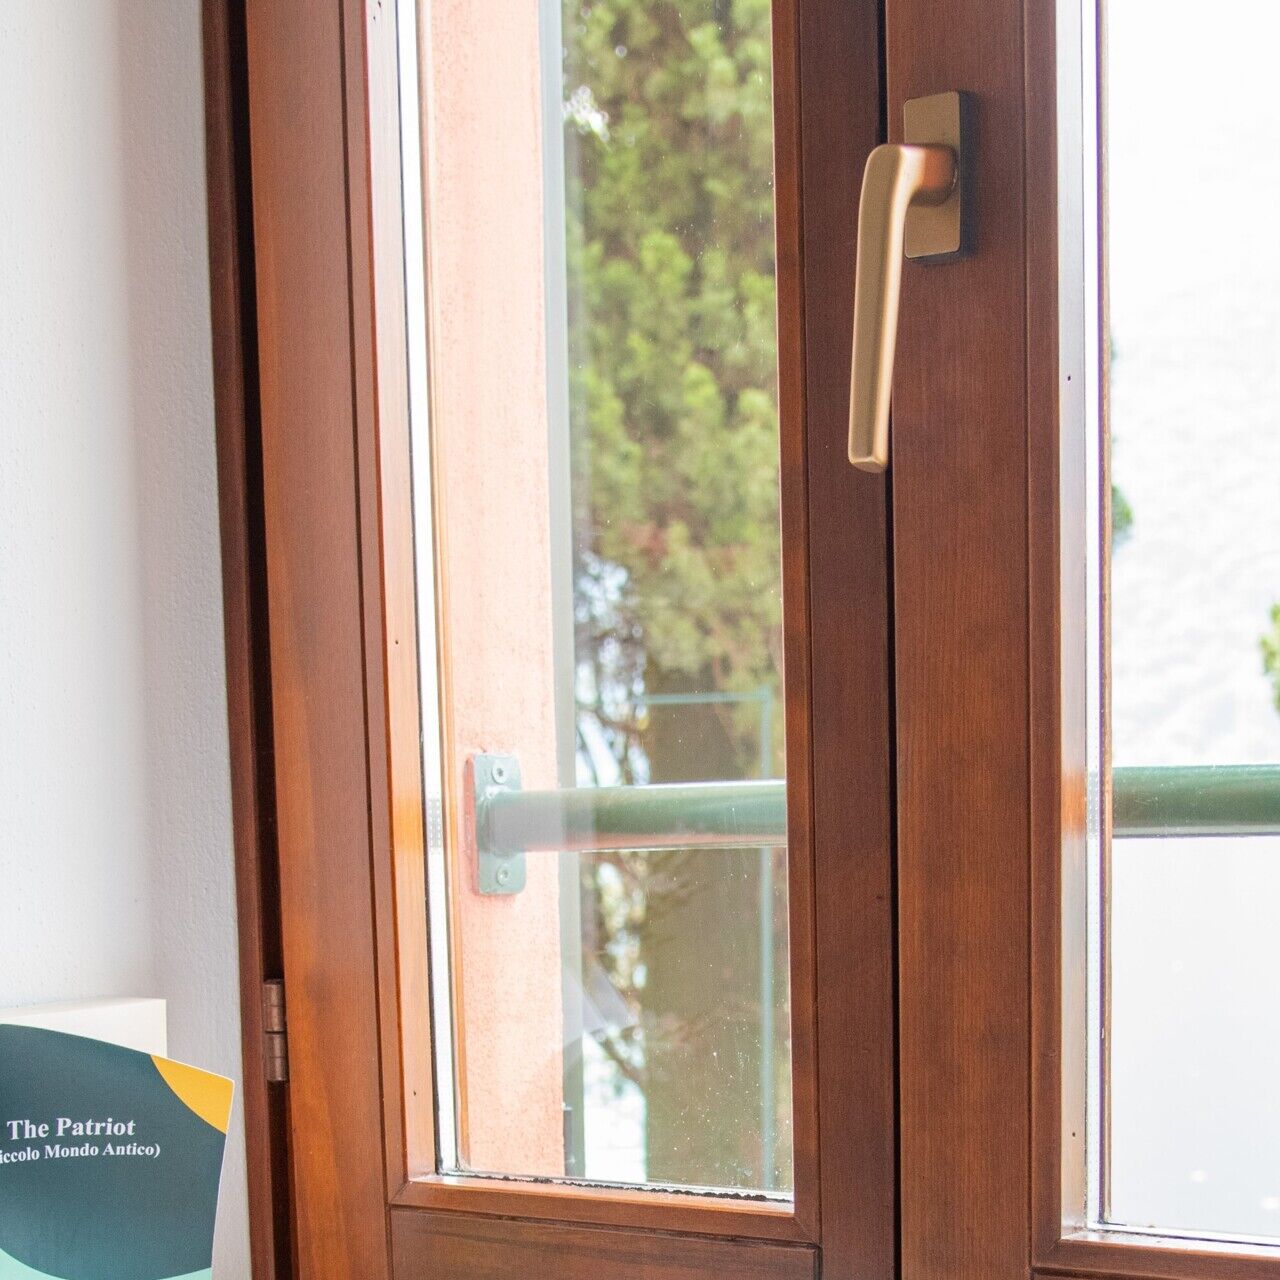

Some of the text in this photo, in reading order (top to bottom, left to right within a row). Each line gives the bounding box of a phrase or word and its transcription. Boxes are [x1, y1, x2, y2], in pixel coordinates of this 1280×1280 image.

[6, 1117, 137, 1141] The Patriot
[44, 1143, 99, 1159] Mondo
[102, 1142, 161, 1159] Antico)
